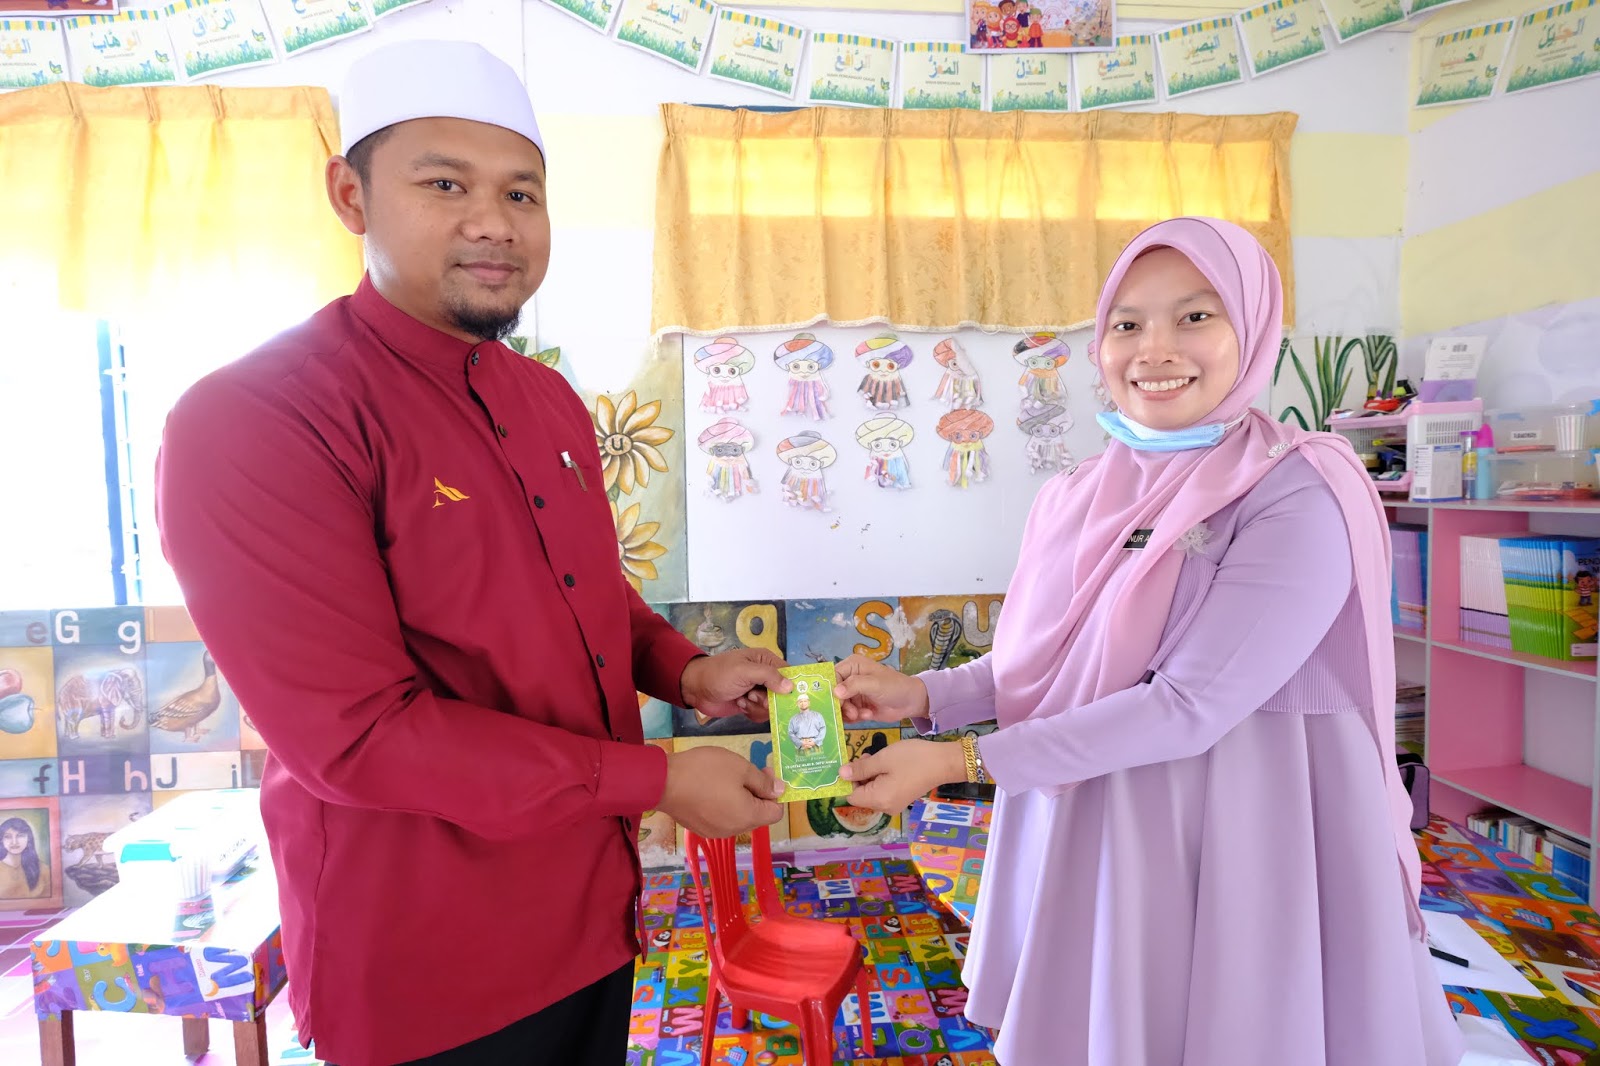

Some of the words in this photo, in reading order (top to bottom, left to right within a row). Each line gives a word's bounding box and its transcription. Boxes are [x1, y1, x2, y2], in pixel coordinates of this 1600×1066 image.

[1128, 534, 1144, 543] NUR
[55, 610, 80, 644] G
[118, 620, 141, 655] g
[33, 763, 52, 794] f
[61, 760, 86, 794] H
[124, 760, 147, 792] h
[155, 757, 177, 789] J
[935, 805, 970, 821] M
[922, 827, 958, 838] L
[851, 861, 873, 873] S
[920, 853, 959, 870] K
[825, 880, 851, 894] M
[892, 874, 920, 892] W
[826, 901, 850, 912] L
[896, 900, 923, 913] V
[678, 914, 702, 927] V
[874, 941, 900, 957] T
[920, 942, 950, 958] Y
[203, 947, 254, 989] M
[678, 959, 707, 974] Y
[880, 968, 911, 983] S
[925, 969, 955, 984] X
[93, 977, 137, 1011] C
[668, 987, 700, 1005] X
[938, 990, 968, 1015] W
[896, 994, 929, 1014] R
[669, 1008, 703, 1036] W
[766, 1034, 799, 1055] B
[898, 1027, 934, 1053] Q
[948, 1029, 982, 1049] V
